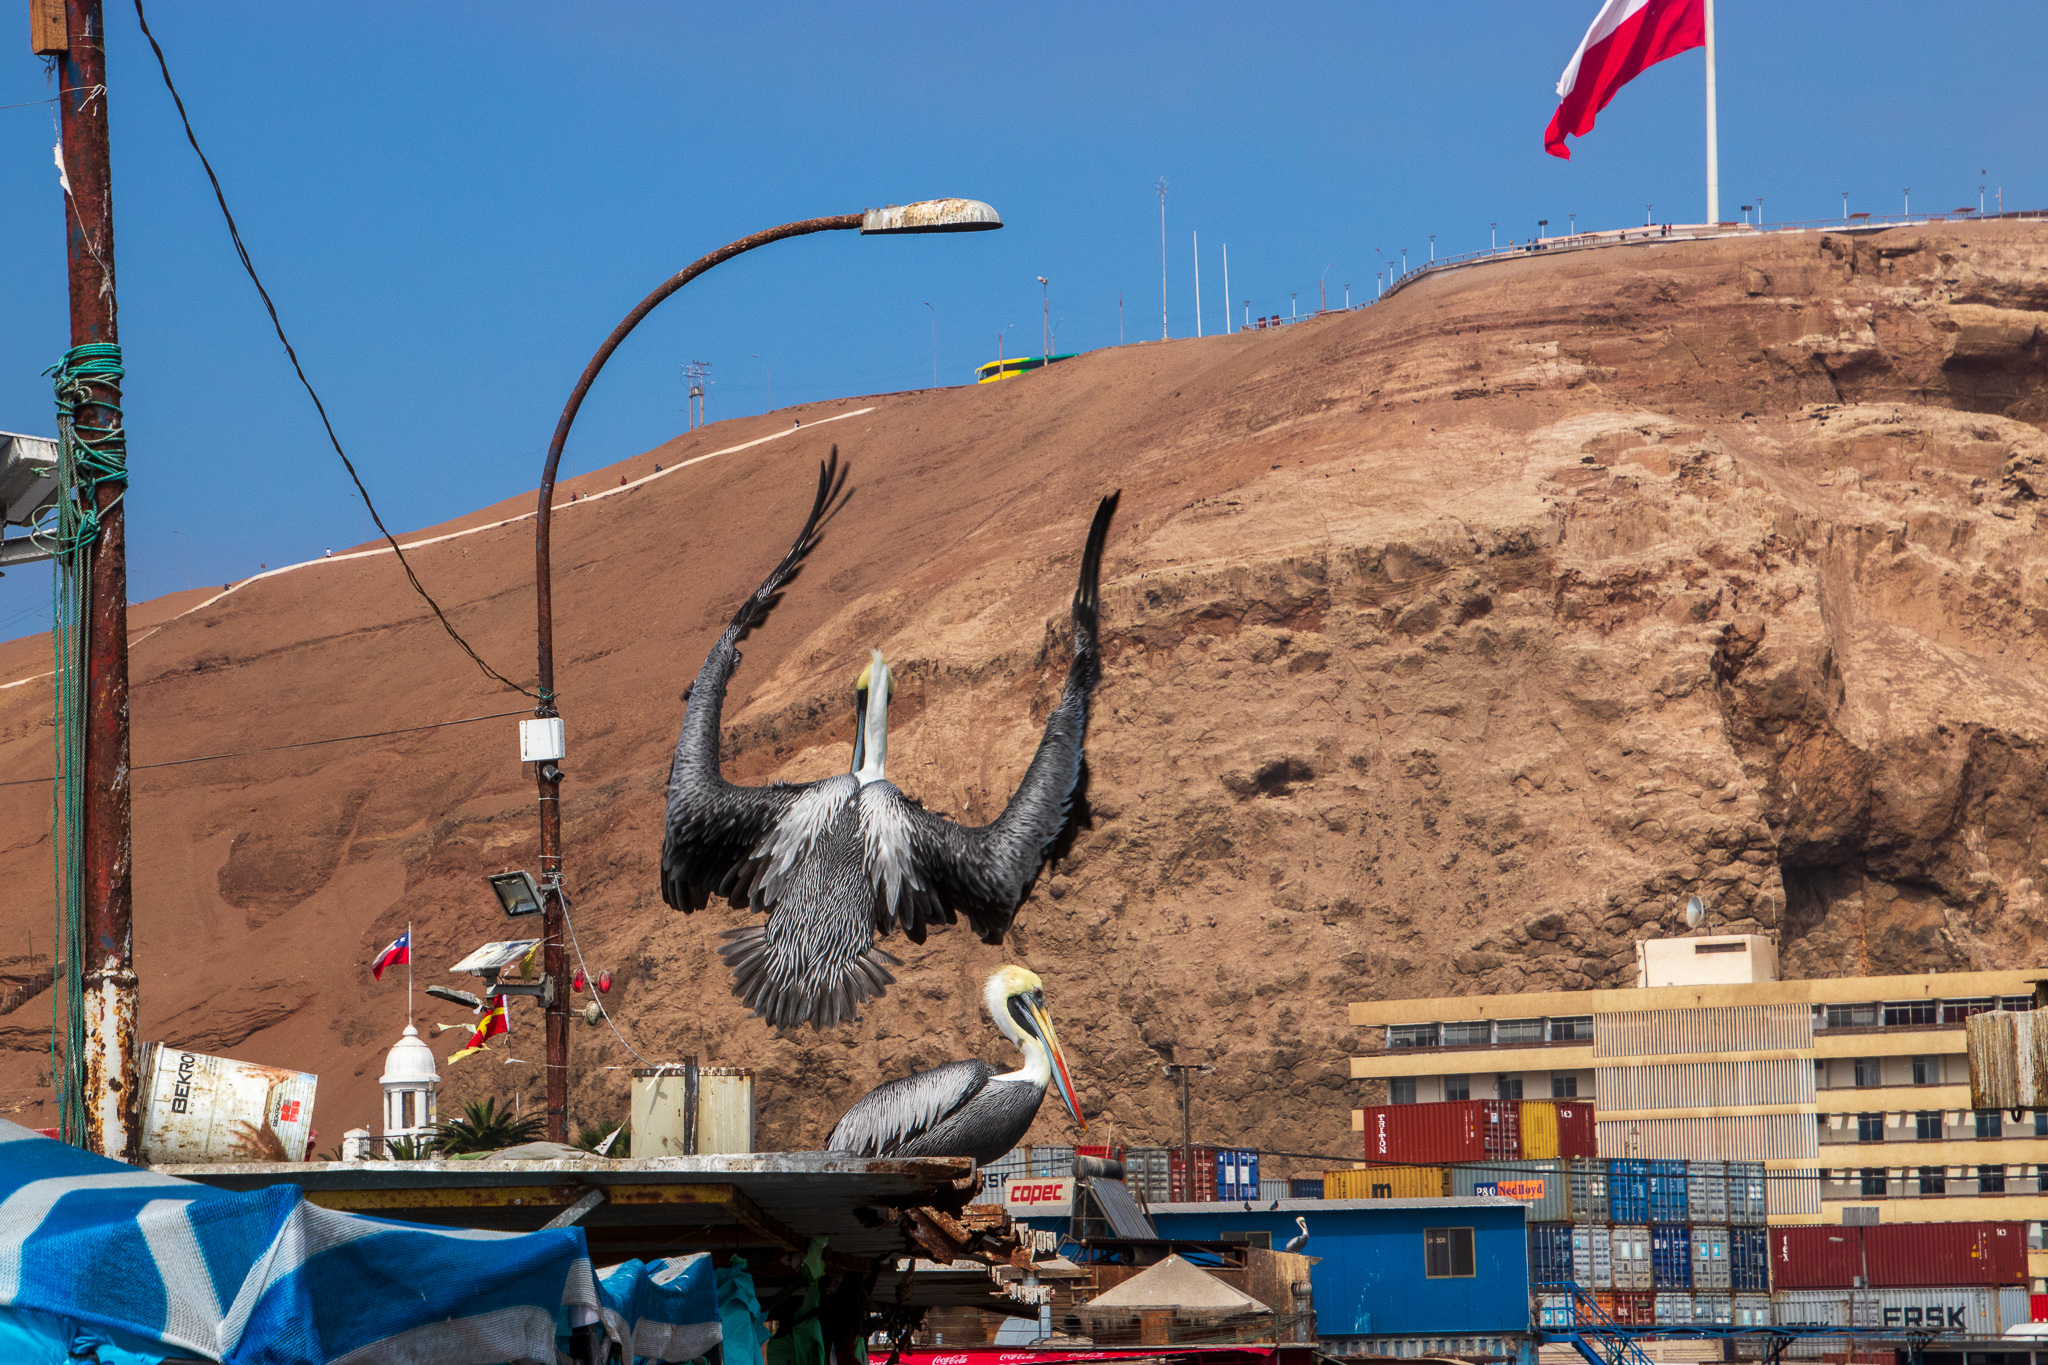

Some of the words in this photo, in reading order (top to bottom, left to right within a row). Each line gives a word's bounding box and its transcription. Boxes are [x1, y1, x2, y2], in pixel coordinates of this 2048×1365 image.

[1377, 1113, 1387, 1154] TRITON
[1011, 1184, 1063, 1205] copec
[1476, 1186, 1496, 1197] P&O
[1500, 1183, 1543, 1197] Nedlloyd
